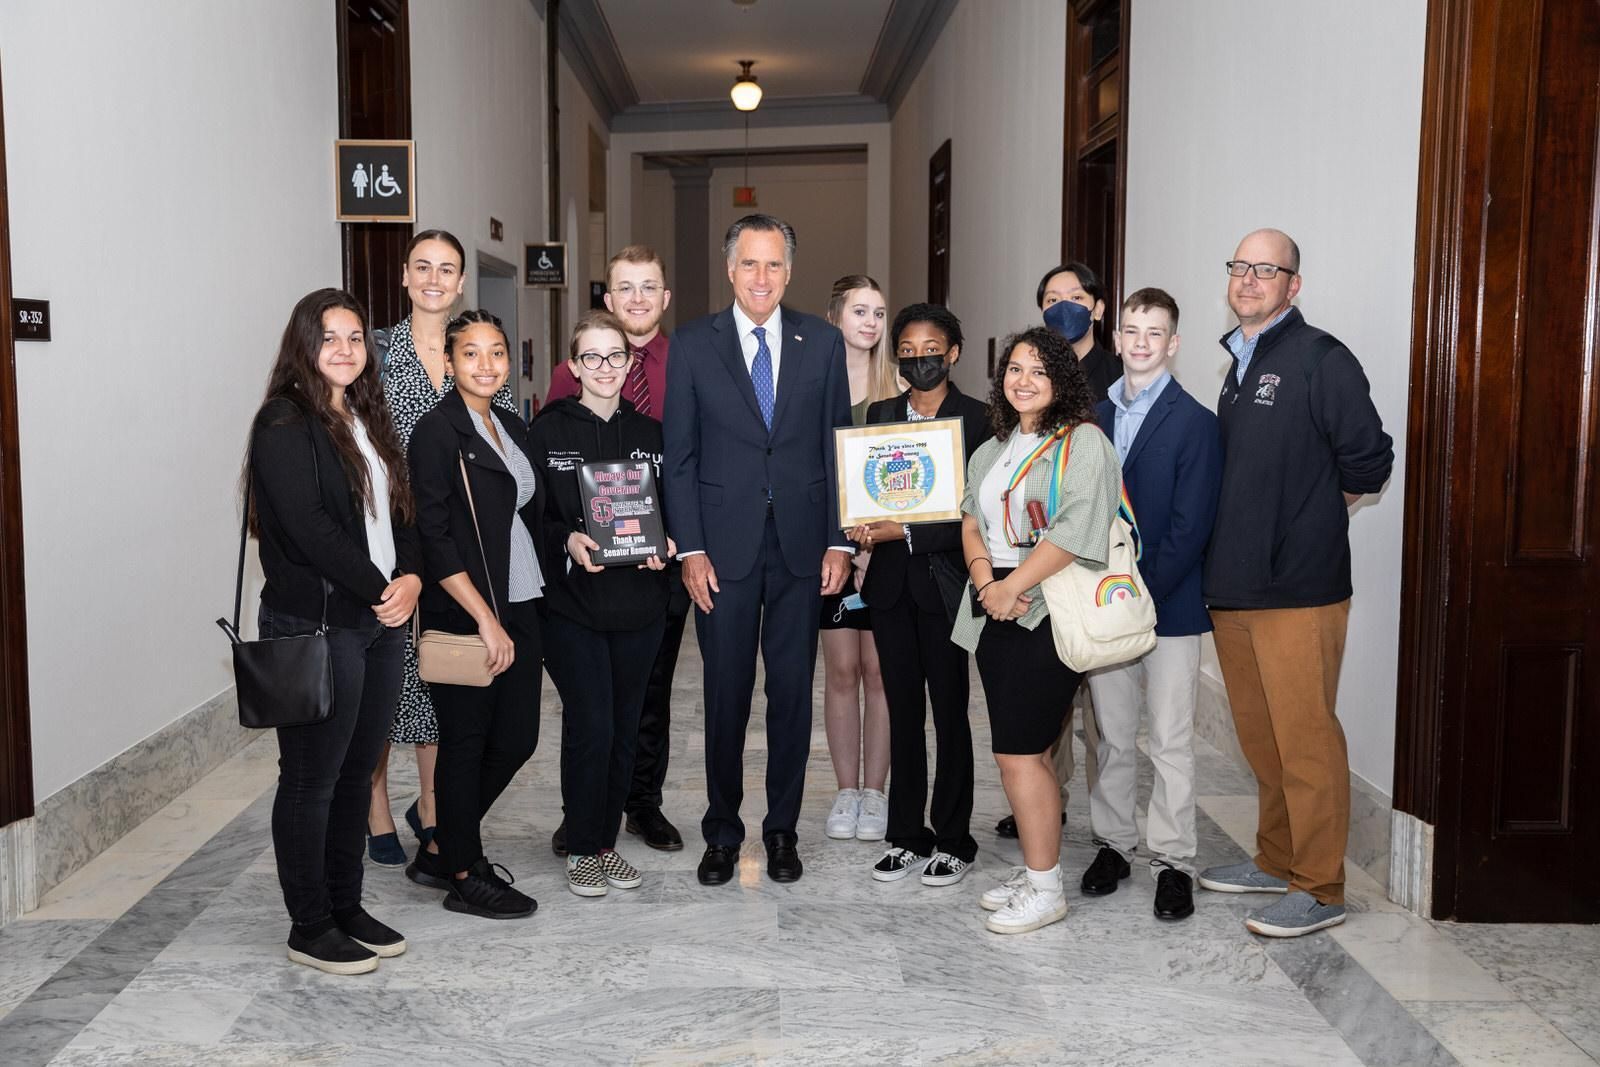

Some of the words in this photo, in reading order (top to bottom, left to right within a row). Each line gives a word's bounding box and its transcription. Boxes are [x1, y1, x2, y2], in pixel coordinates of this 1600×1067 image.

[594, 470, 626, 482] Always
[626, 469, 642, 480] Our
[599, 484, 640, 496] Governor
[612, 536, 632, 545] Thank
[634, 536, 646, 544] you
[603, 548, 630, 558] Senator
[630, 546, 657, 556] Romney
